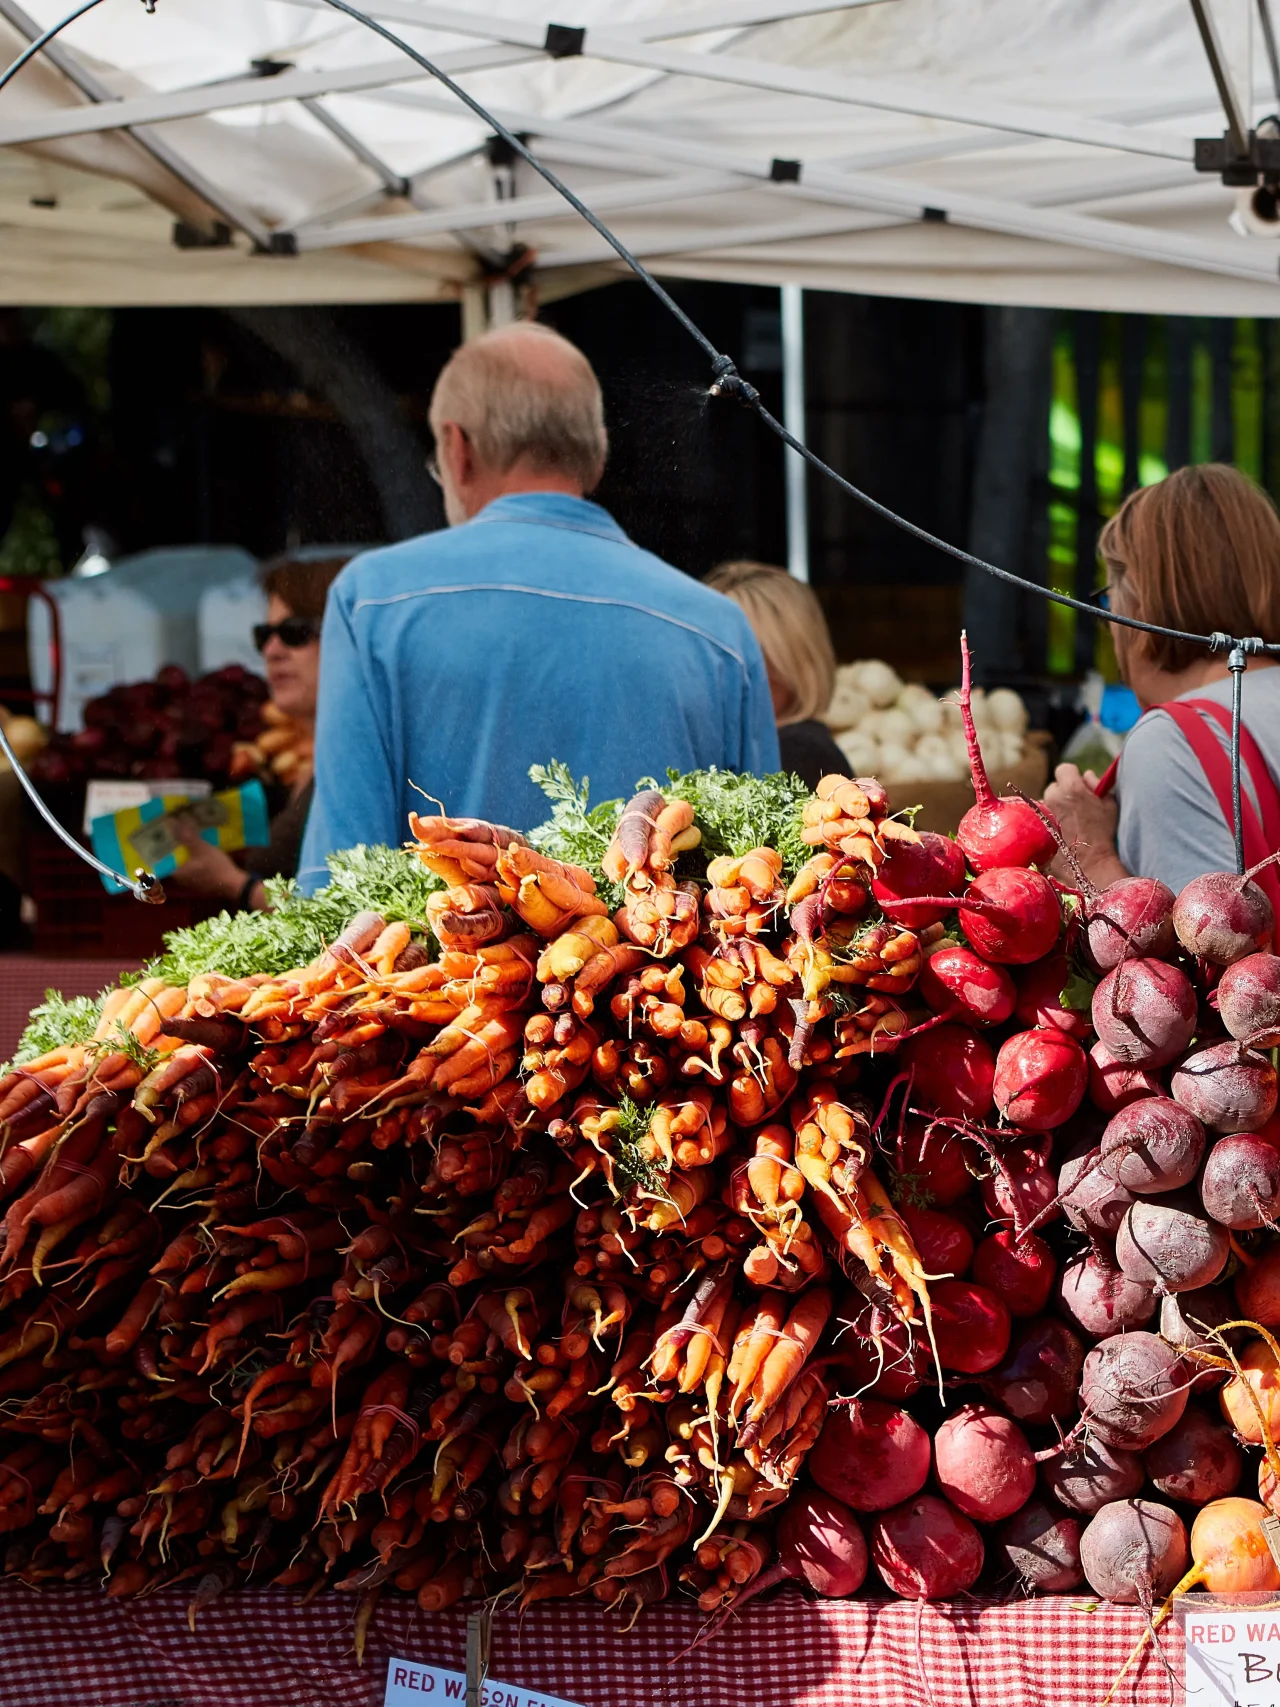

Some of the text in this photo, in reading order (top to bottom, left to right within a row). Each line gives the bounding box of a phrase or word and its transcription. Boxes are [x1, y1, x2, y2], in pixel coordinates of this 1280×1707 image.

[1191, 1624, 1236, 1644] RED
[394, 1667, 519, 1707] RED WGON
